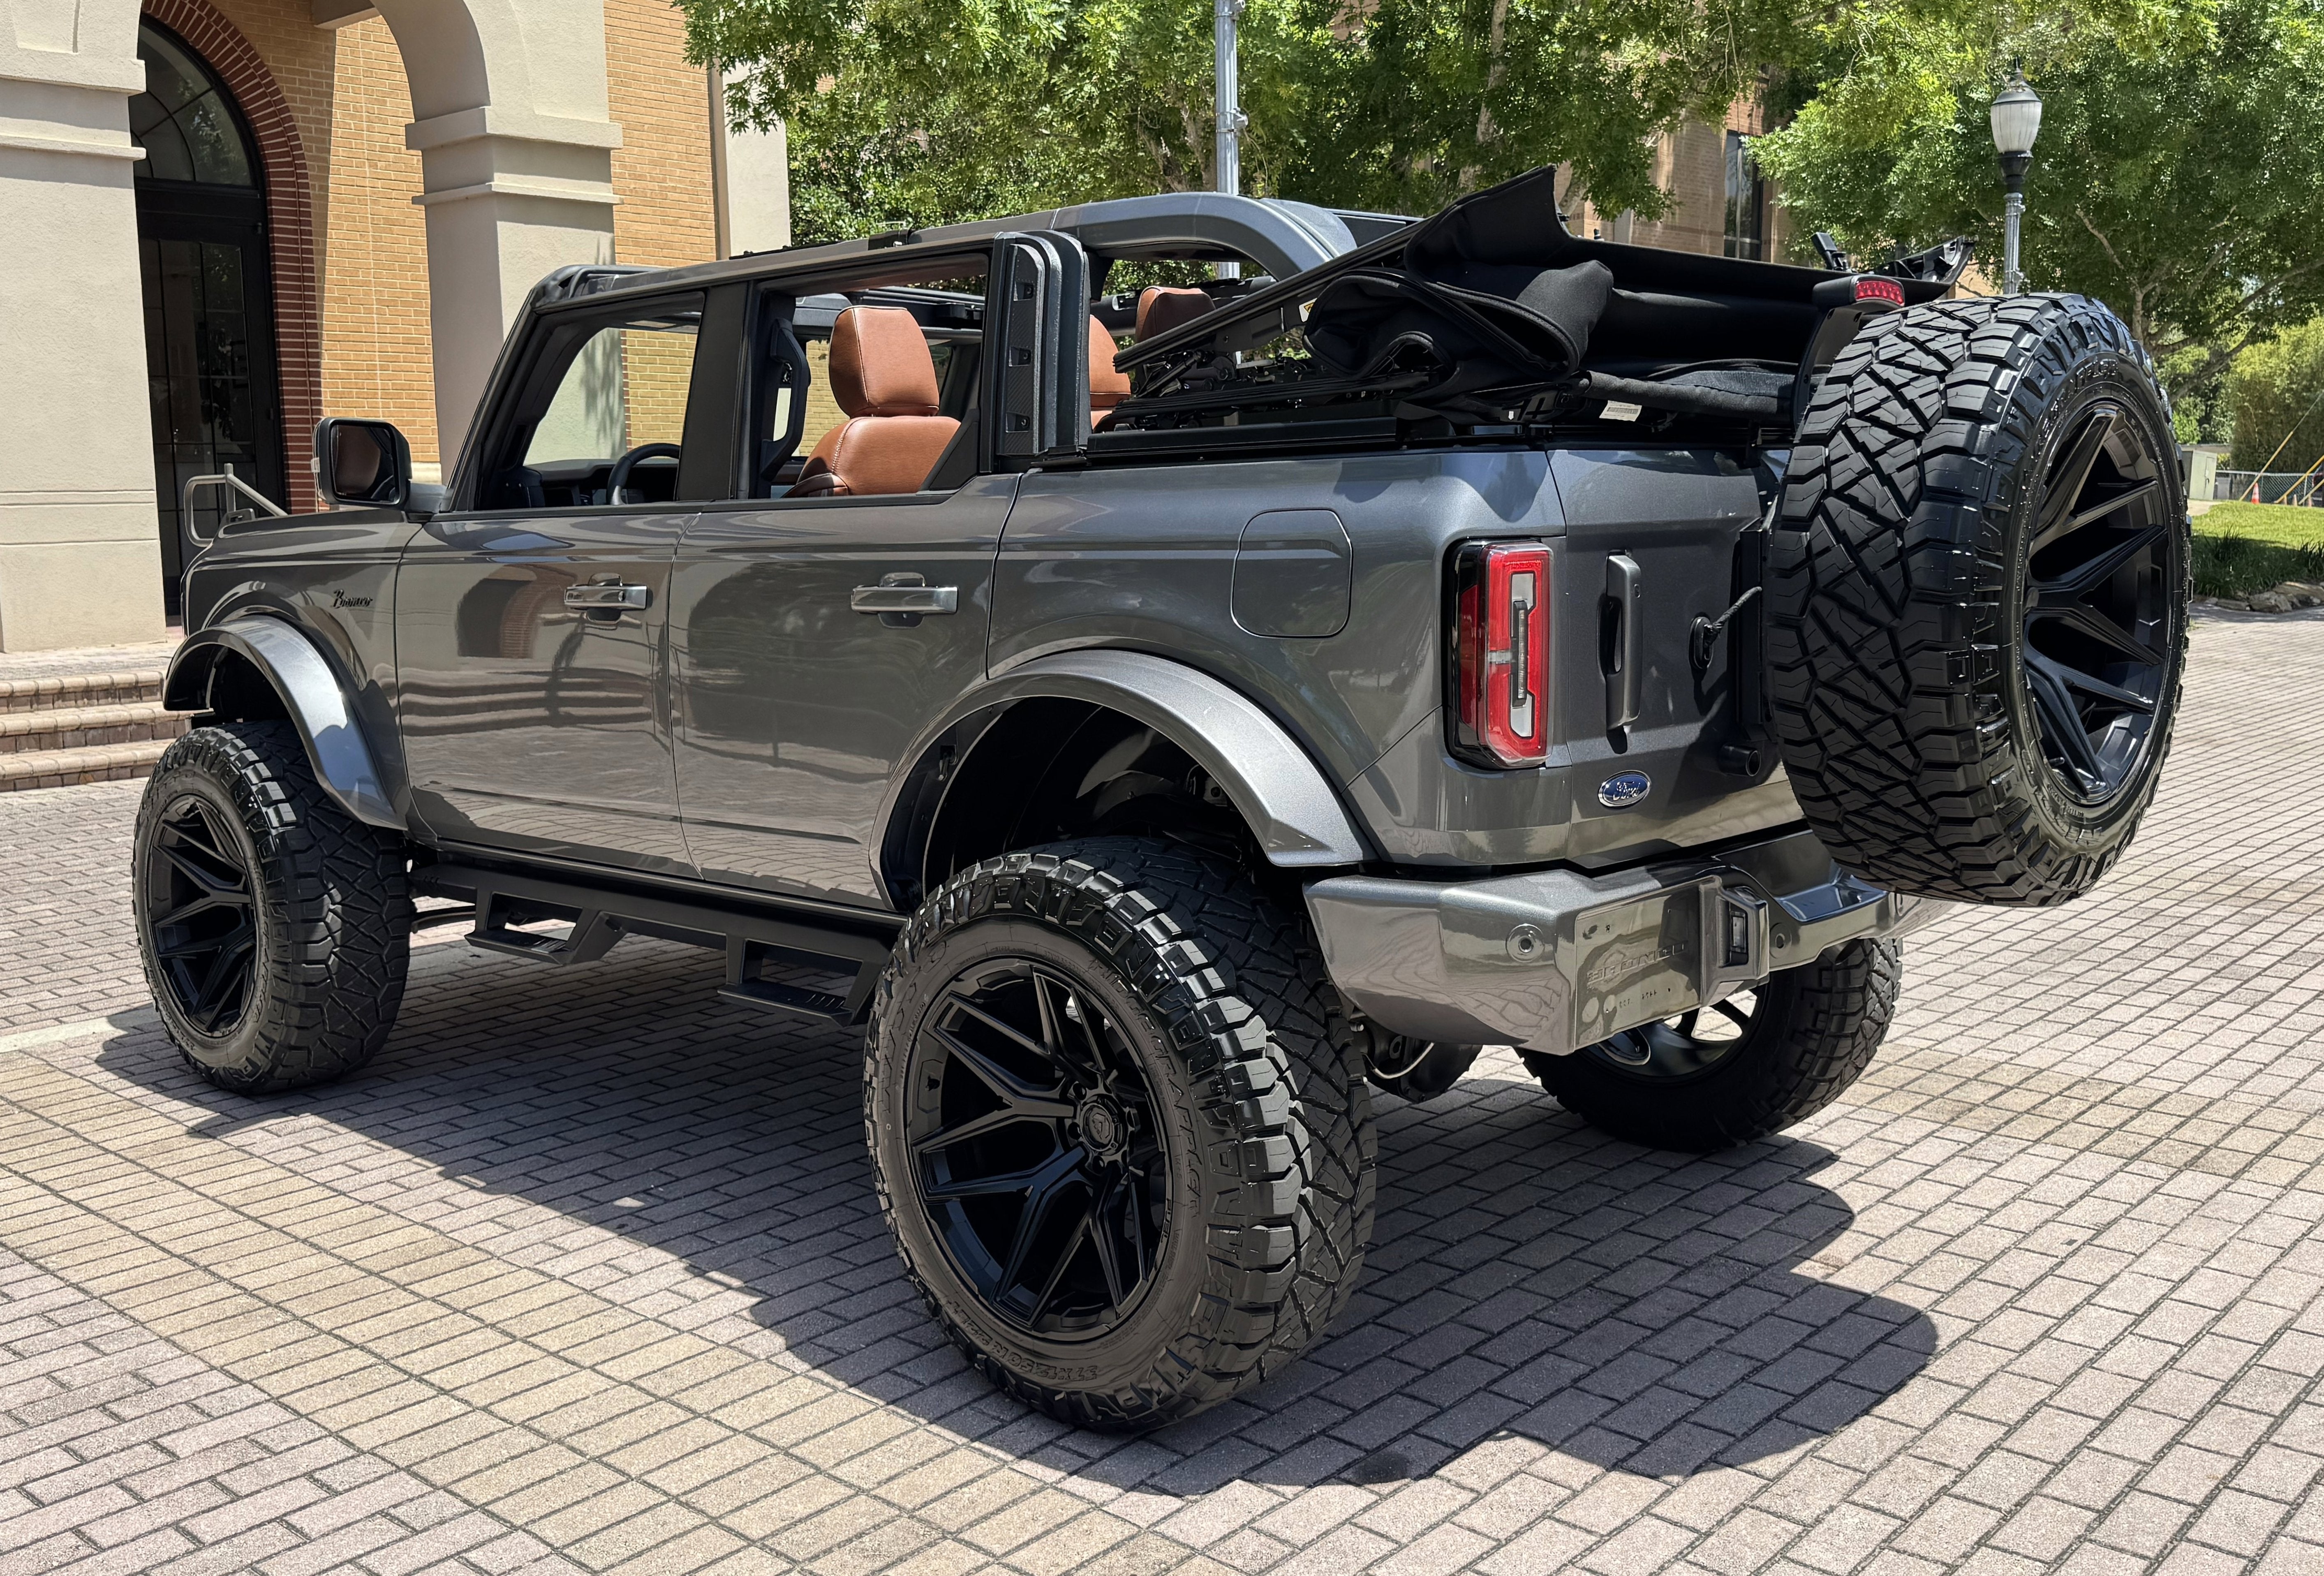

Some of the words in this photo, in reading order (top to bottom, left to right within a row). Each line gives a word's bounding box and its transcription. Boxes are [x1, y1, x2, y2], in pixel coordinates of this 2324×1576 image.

[333, 589, 373, 609] Bronco
[1613, 780, 1640, 801] Ford
[1587, 942, 1686, 985] BRONCO
[1088, 958, 1155, 1032] RIDGE
[1151, 1035, 1202, 1218] GRAPPLER
[1161, 1198, 1172, 1244] FUEL
